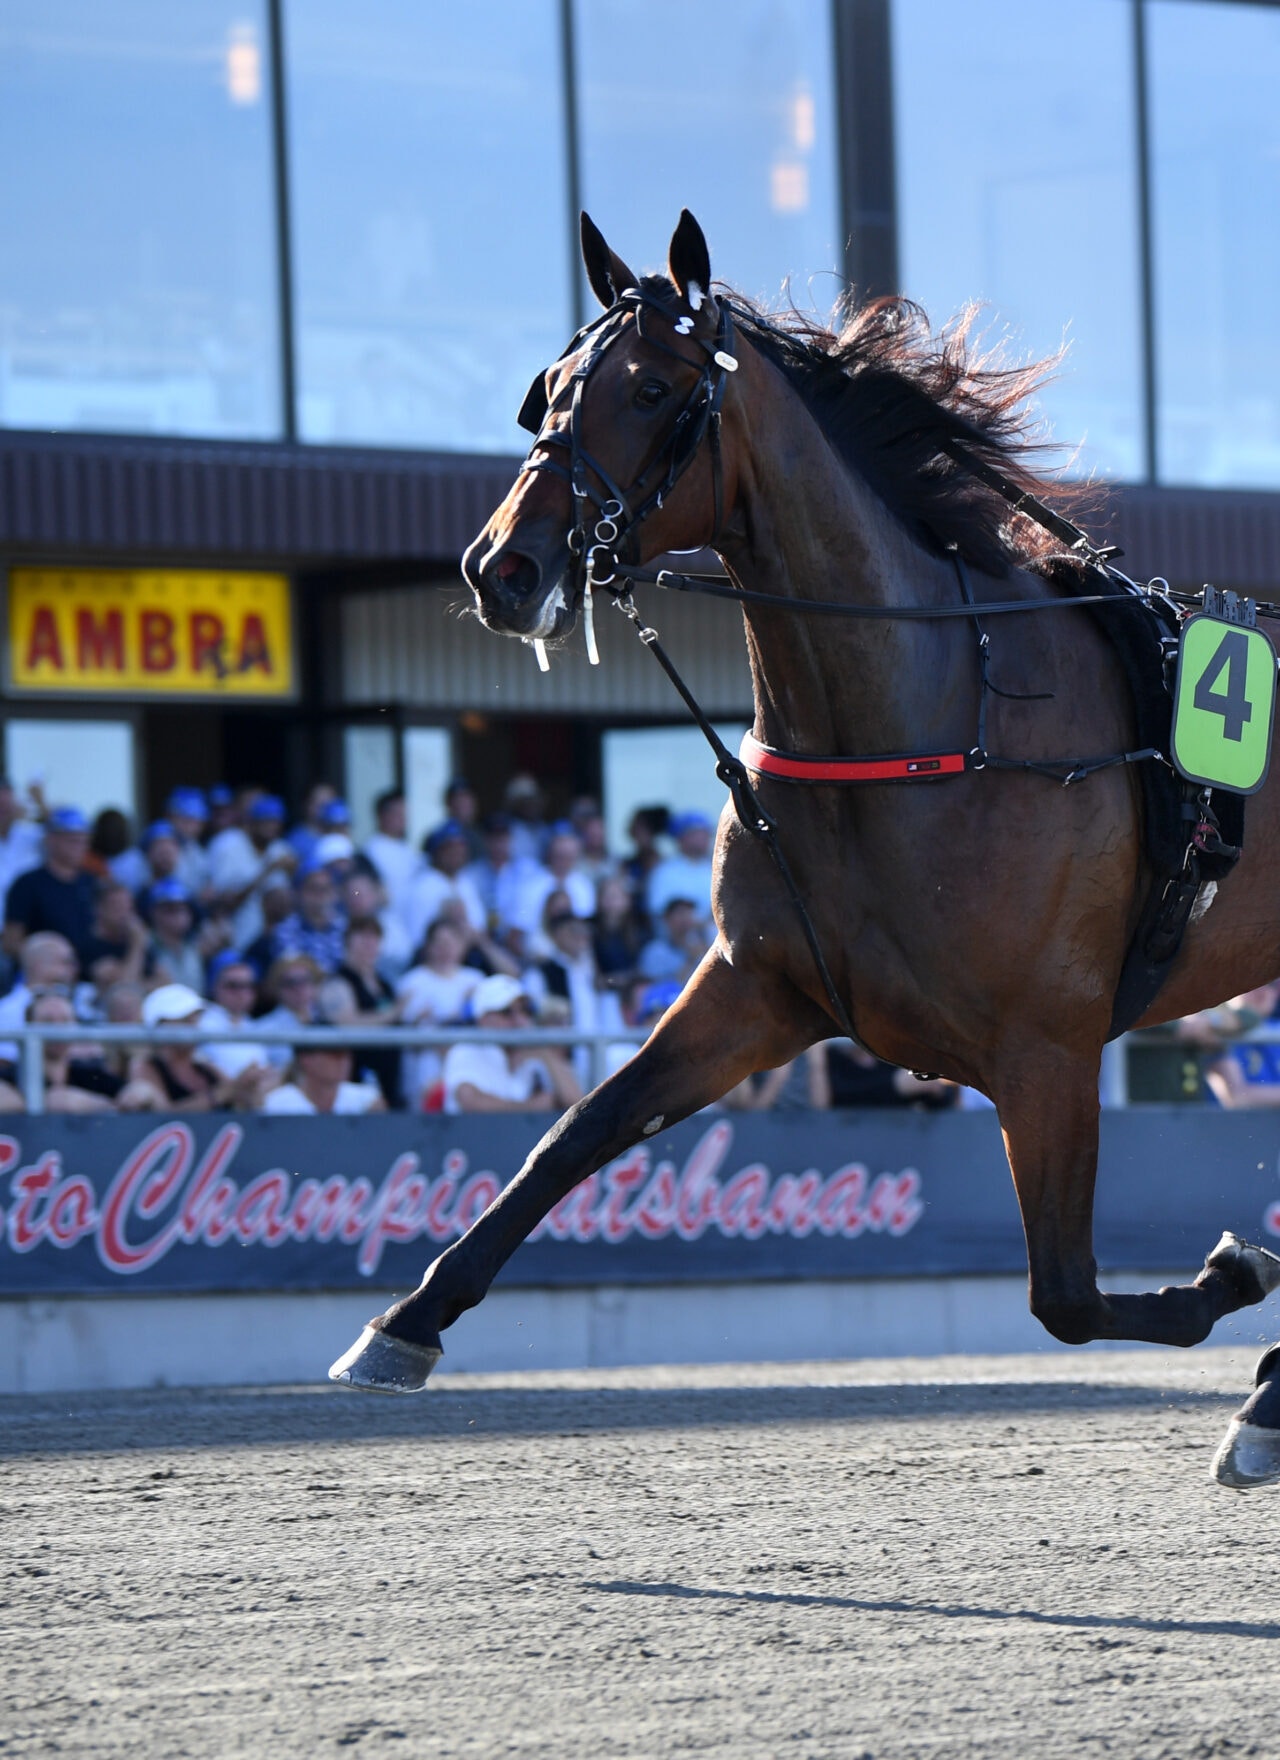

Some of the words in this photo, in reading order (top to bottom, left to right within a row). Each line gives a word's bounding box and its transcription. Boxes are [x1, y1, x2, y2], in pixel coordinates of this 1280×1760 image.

[25, 603, 274, 680] AMBRA
[1193, 629, 1252, 742] 4
[0, 1118, 925, 1276] toChampioatsbanan
